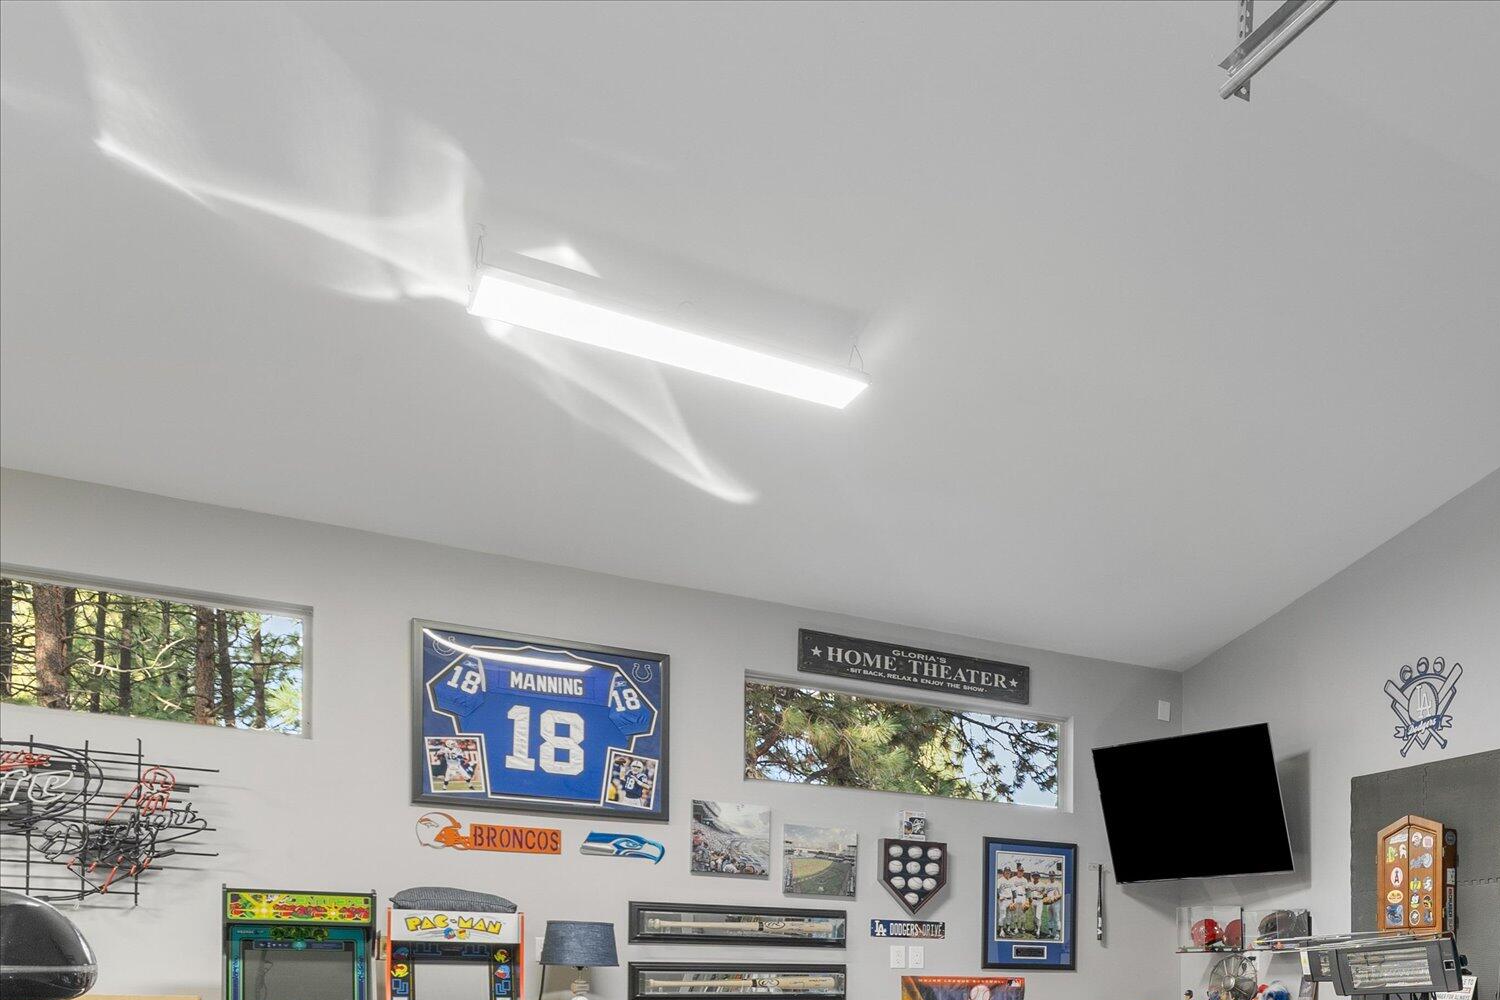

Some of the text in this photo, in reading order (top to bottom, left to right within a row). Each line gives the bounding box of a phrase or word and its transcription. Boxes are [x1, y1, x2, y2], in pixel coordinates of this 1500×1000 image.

[826, 645, 1008, 689] HOME THEATER
[891, 649, 947, 664] GLORIA'S
[446, 665, 481, 695] 18
[510, 670, 584, 696] MANNING
[886, 673, 912, 682] RELAX
[920, 678, 944, 687] ENJOY
[946, 682, 960, 690] THE
[963, 685, 984, 693] SHOW
[611, 688, 641, 712] 18
[505, 704, 584, 776] 18
[472, 826, 560, 852] BRONCOS
[405, 914, 502, 935] PAC-MAN
[874, 920, 942, 937] LA DODGERS DRIVE
